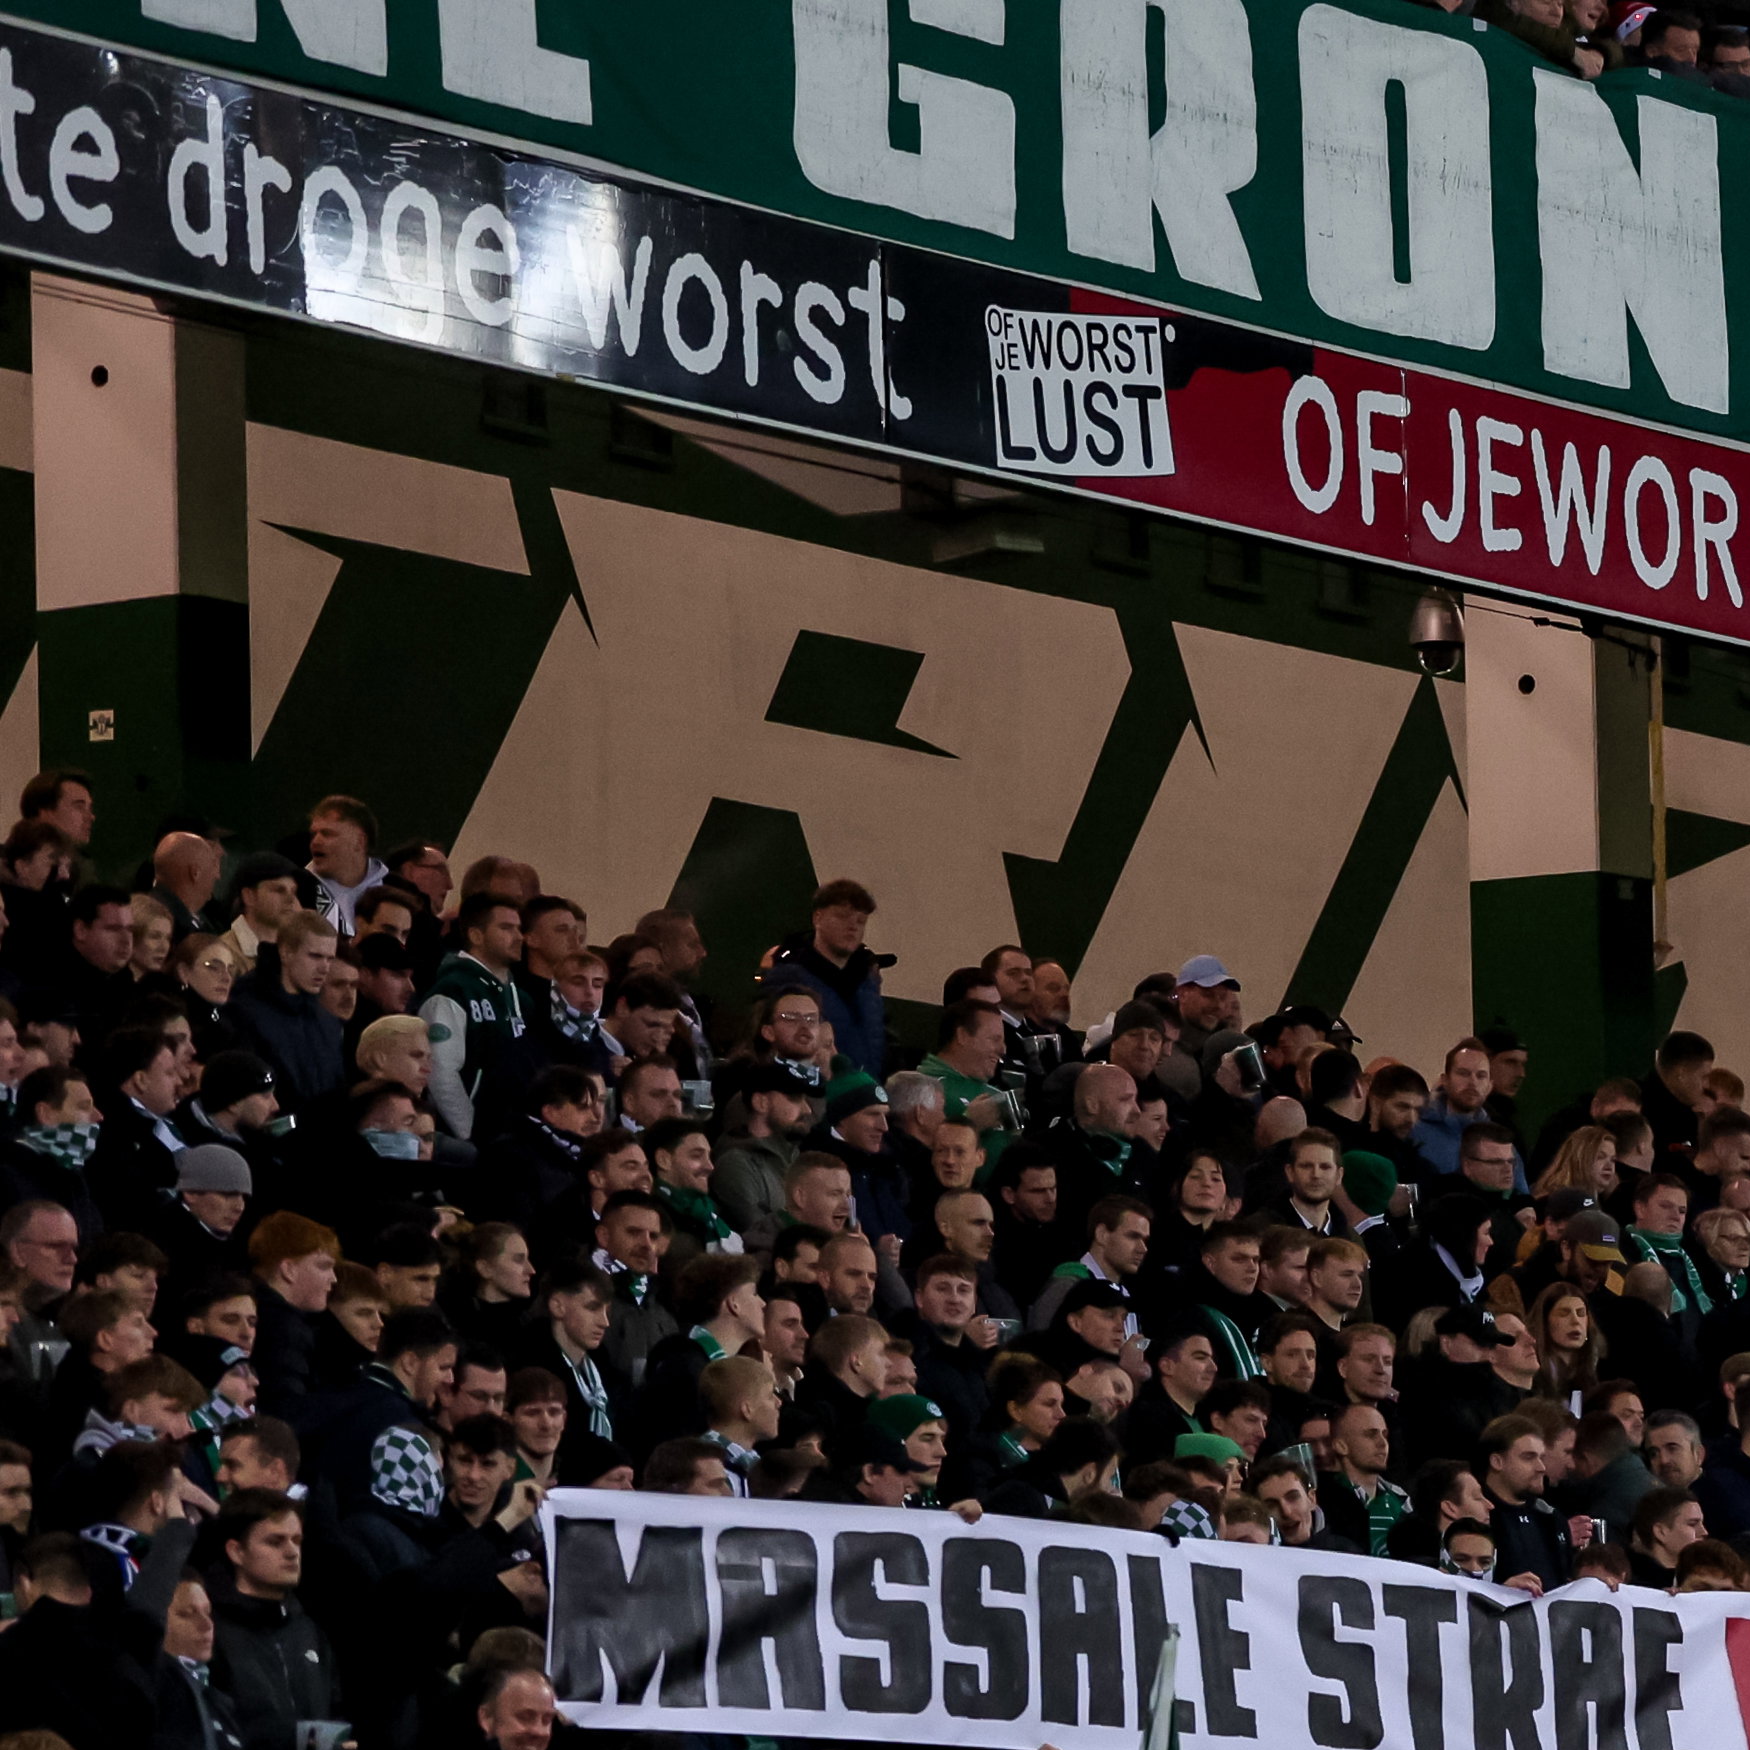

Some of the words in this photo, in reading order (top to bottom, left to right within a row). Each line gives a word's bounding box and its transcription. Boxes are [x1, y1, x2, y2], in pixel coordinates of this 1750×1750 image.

[168, 93, 519, 340] droge
[566, 225, 912, 420] worst
[987, 308, 1014, 340] OF
[995, 342, 1020, 371] JE
[1018, 317, 1158, 375] WORST
[996, 374, 1163, 469] LUST
[552, 1515, 1259, 1739] MASSALE
